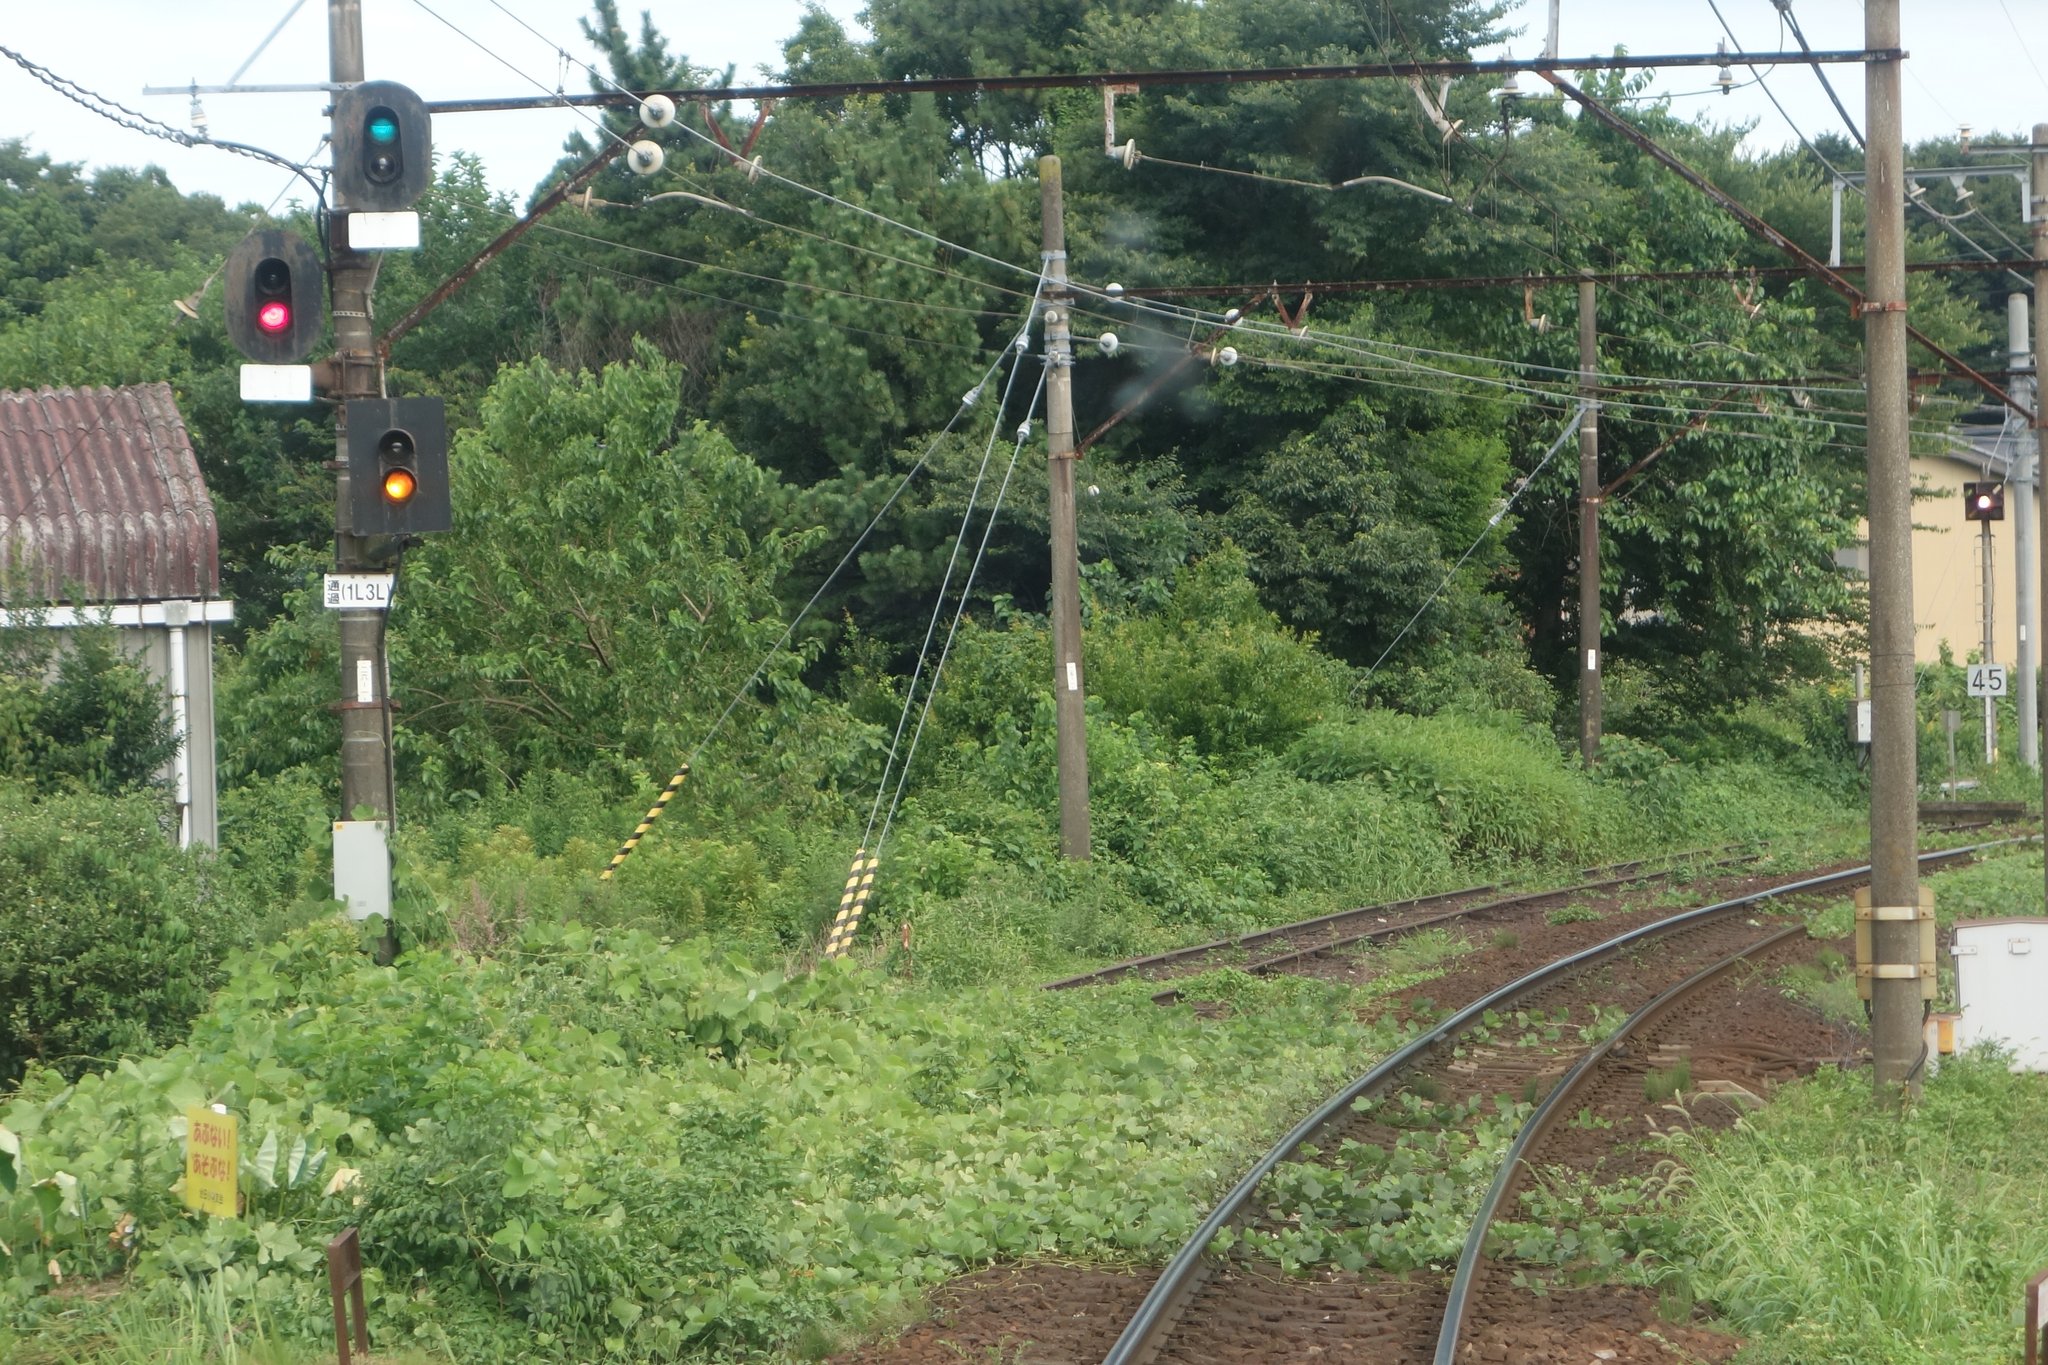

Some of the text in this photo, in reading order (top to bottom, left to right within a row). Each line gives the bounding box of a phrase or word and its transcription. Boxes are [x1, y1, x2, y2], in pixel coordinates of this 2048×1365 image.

[327, 579, 340, 605] 通過
[1972, 669, 2002, 691] 45
[192, 1120, 231, 1150] あぶない!
[192, 1151, 231, 1182] あそぶな!
